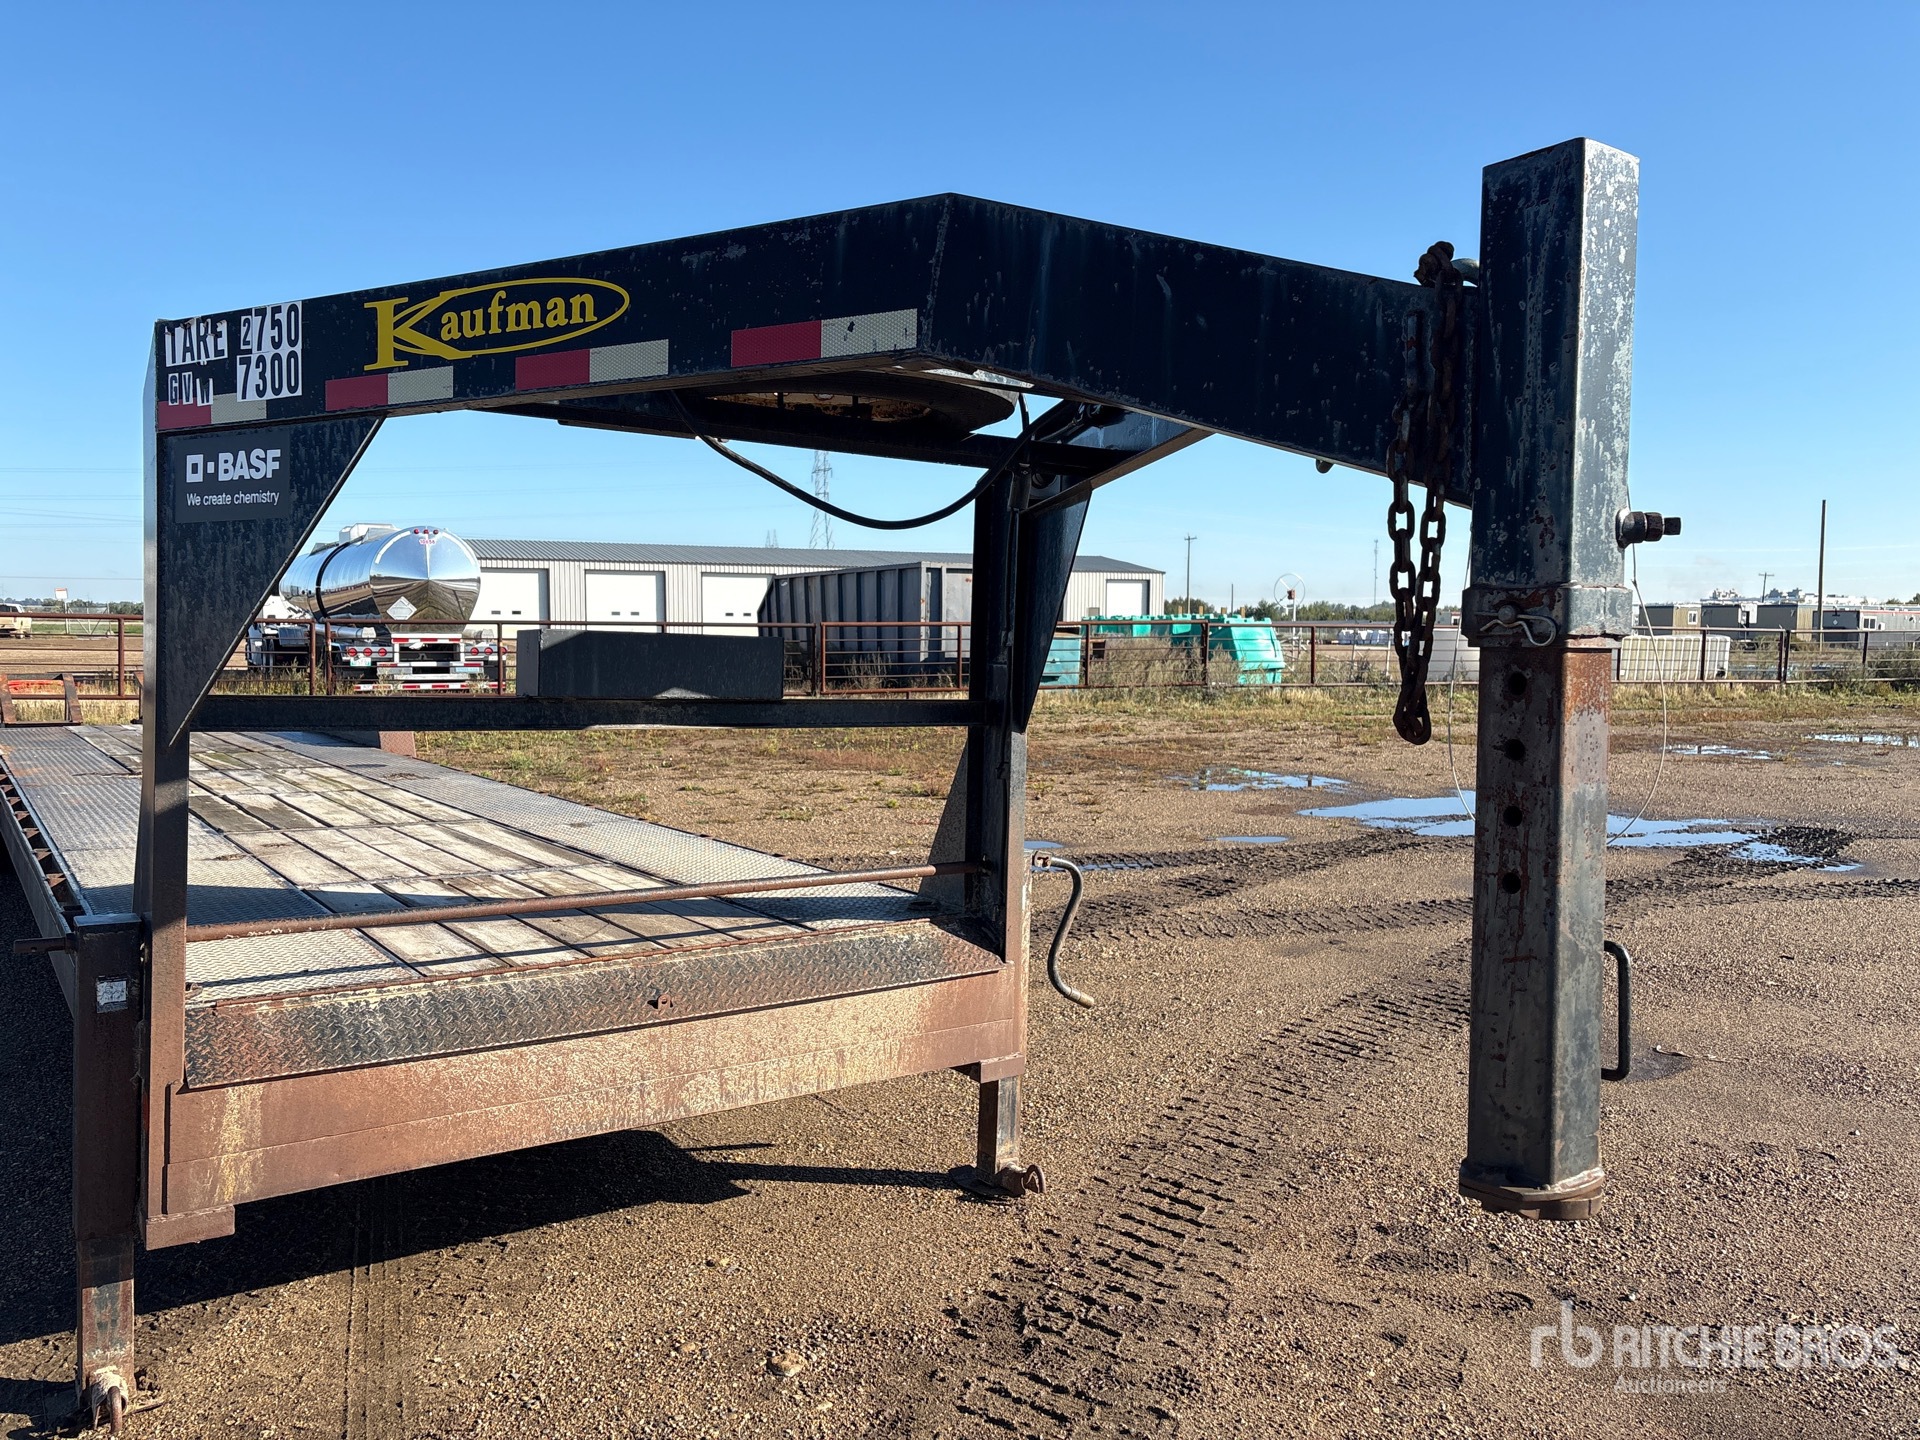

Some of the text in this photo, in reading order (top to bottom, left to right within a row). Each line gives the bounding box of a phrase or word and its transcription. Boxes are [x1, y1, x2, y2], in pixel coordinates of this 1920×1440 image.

[165, 303, 301, 365] TARE 2750
[364, 289, 598, 371] Kaufman
[168, 350, 301, 405] GVW 7300
[218, 448, 281, 481] BASF
[186, 490, 280, 506] We create chemistry
